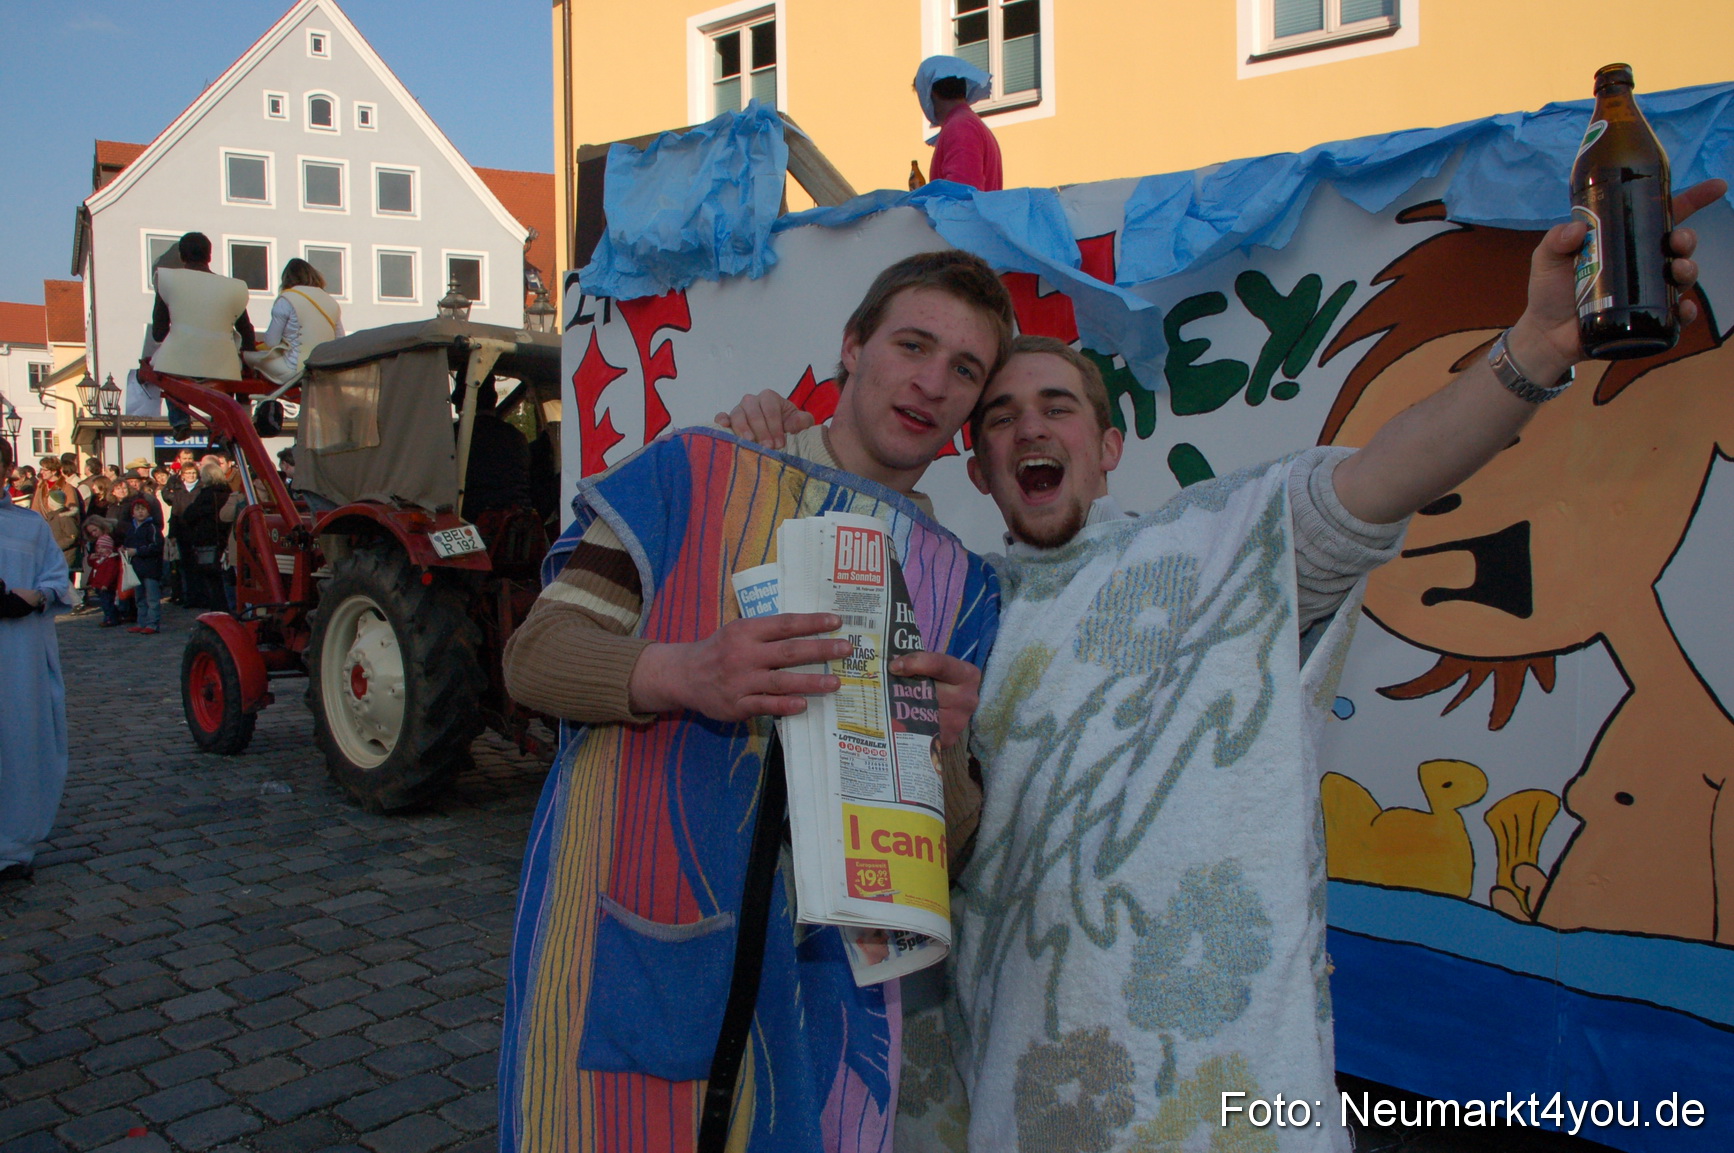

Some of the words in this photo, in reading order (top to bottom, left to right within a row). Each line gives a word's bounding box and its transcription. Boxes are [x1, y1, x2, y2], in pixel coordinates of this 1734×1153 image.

[441, 529, 466, 543] BEI
[443, 543, 456, 555] R
[456, 537, 479, 552] 192
[838, 530, 881, 573] Bild
[837, 572, 849, 580] am
[850, 571, 881, 584] Sonntag
[745, 606, 757, 618] in
[757, 601, 773, 615] der
[849, 634, 863, 647] DIE
[847, 647, 879, 660] TAGS-
[842, 658, 868, 672] FRAGE
[893, 680, 933, 700] nach
[838, 733, 887, 749] LOTTOZAHLEN
[849, 814, 861, 850] I
[870, 829, 934, 863] can
